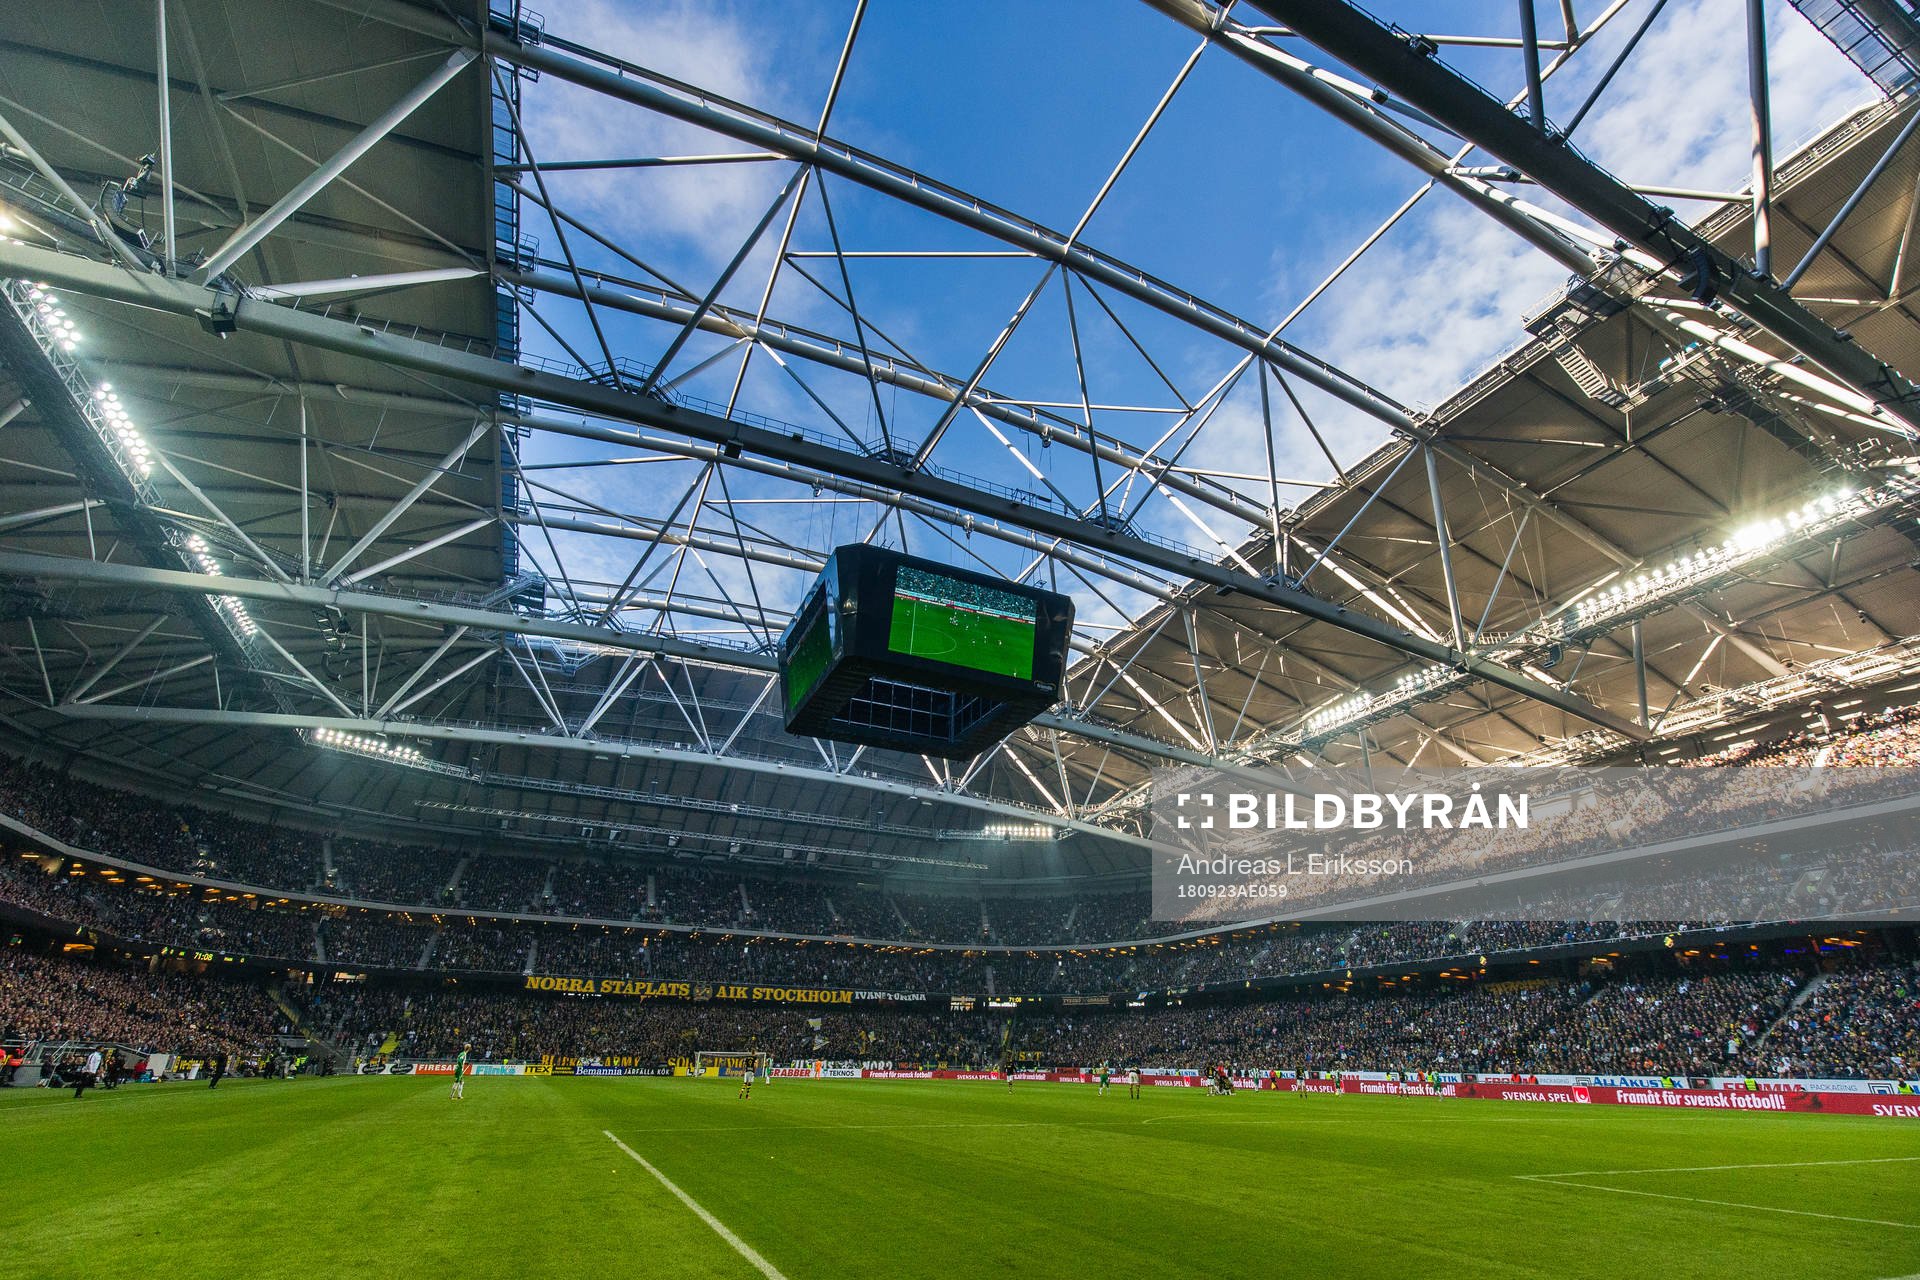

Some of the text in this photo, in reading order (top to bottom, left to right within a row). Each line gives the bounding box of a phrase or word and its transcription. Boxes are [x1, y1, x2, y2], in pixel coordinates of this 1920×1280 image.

[525, 976, 853, 1004] NORRA STÅPLATS AIK STOCKHOLM
[576, 1066, 622, 1075] Bemannia
[1291, 1084, 1334, 1093] SVSKA SPEL
[1360, 1082, 1385, 1093] Framåt
[1386, 1083, 1398, 1094] för
[1425, 1084, 1457, 1096] fooll!
[1810, 1084, 1858, 1092] PACKAGING
[1502, 1091, 1574, 1103] SVENSKA SPEL
[1616, 1089, 1787, 1109] Framåt för svensk fotboll!
